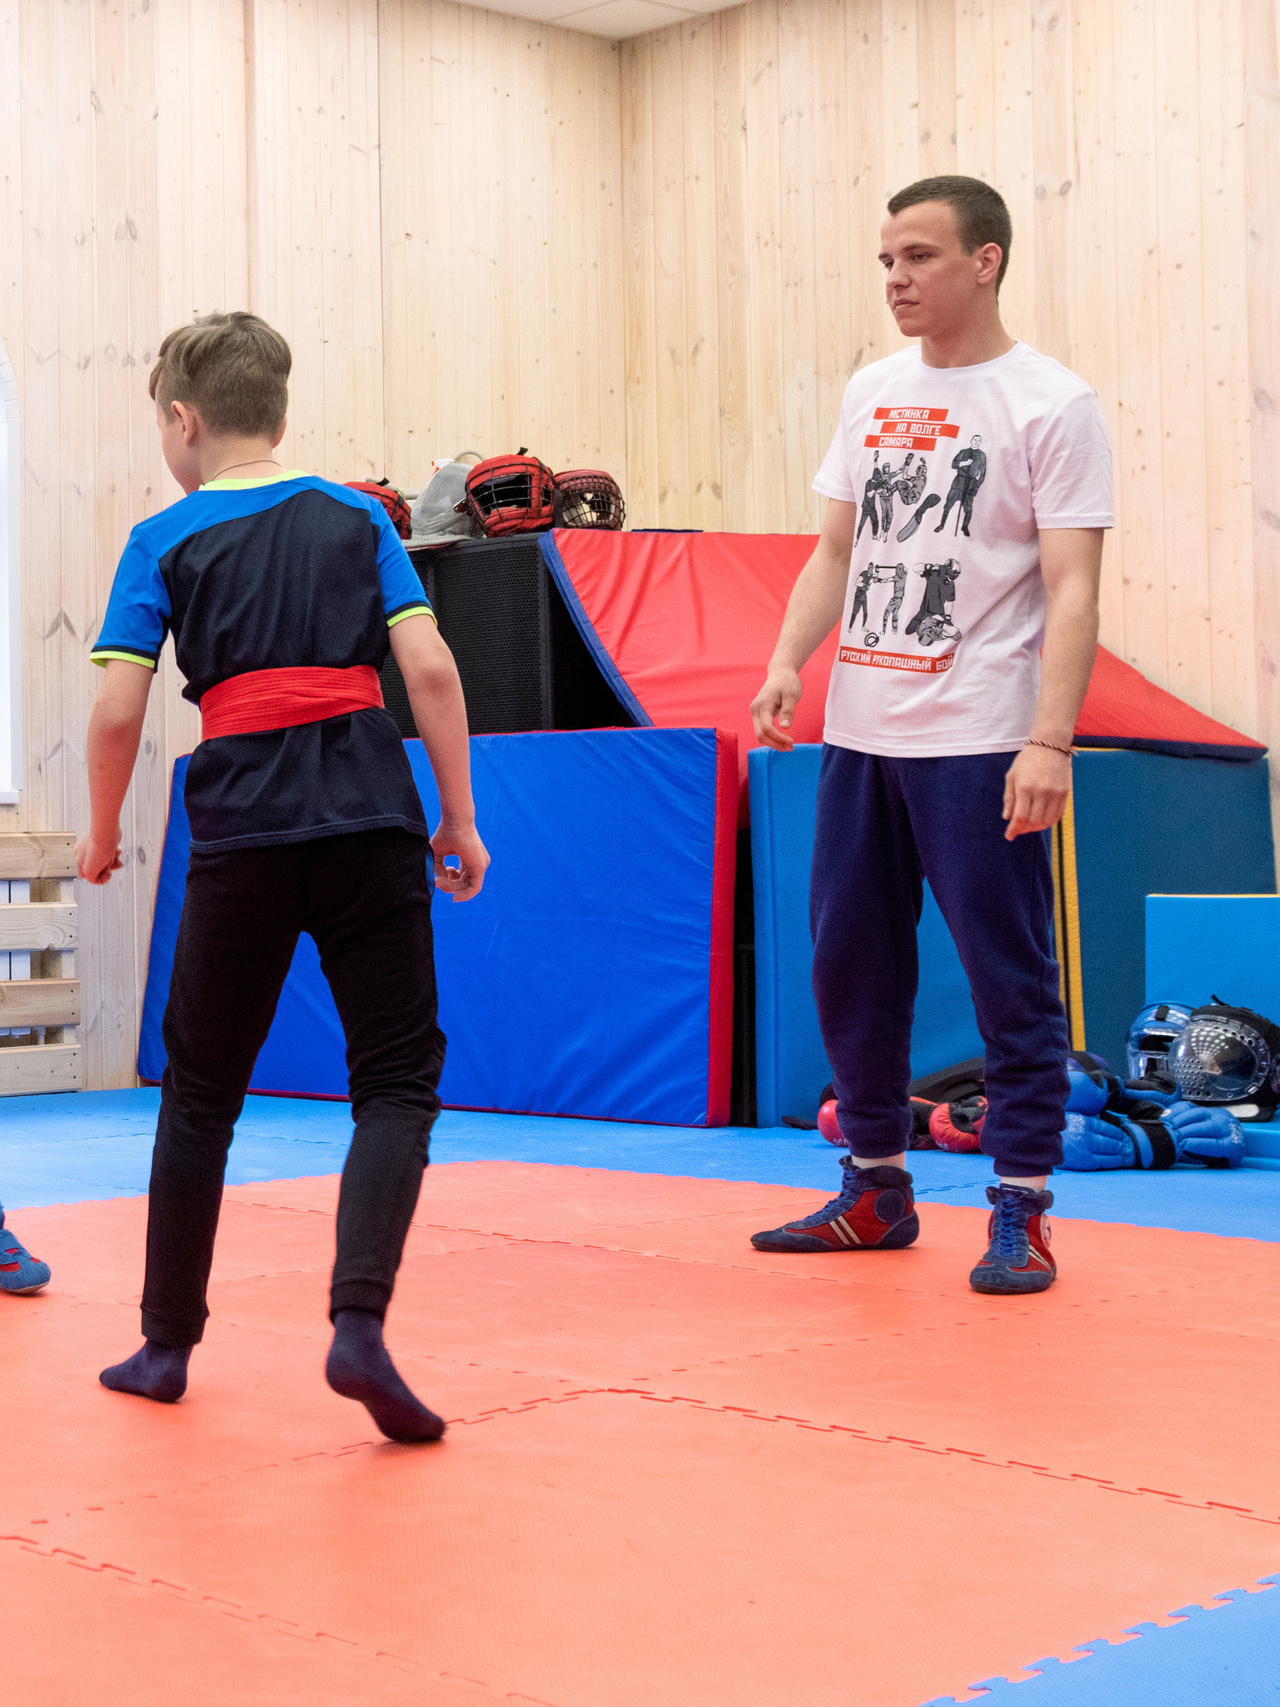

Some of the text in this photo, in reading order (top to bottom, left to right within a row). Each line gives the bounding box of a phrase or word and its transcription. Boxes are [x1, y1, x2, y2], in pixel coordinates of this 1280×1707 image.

[888, 408, 930, 420] МСТИНКА
[895, 423, 941, 436] НА ВОЛГЕ
[878, 437, 913, 448] САМАРА
